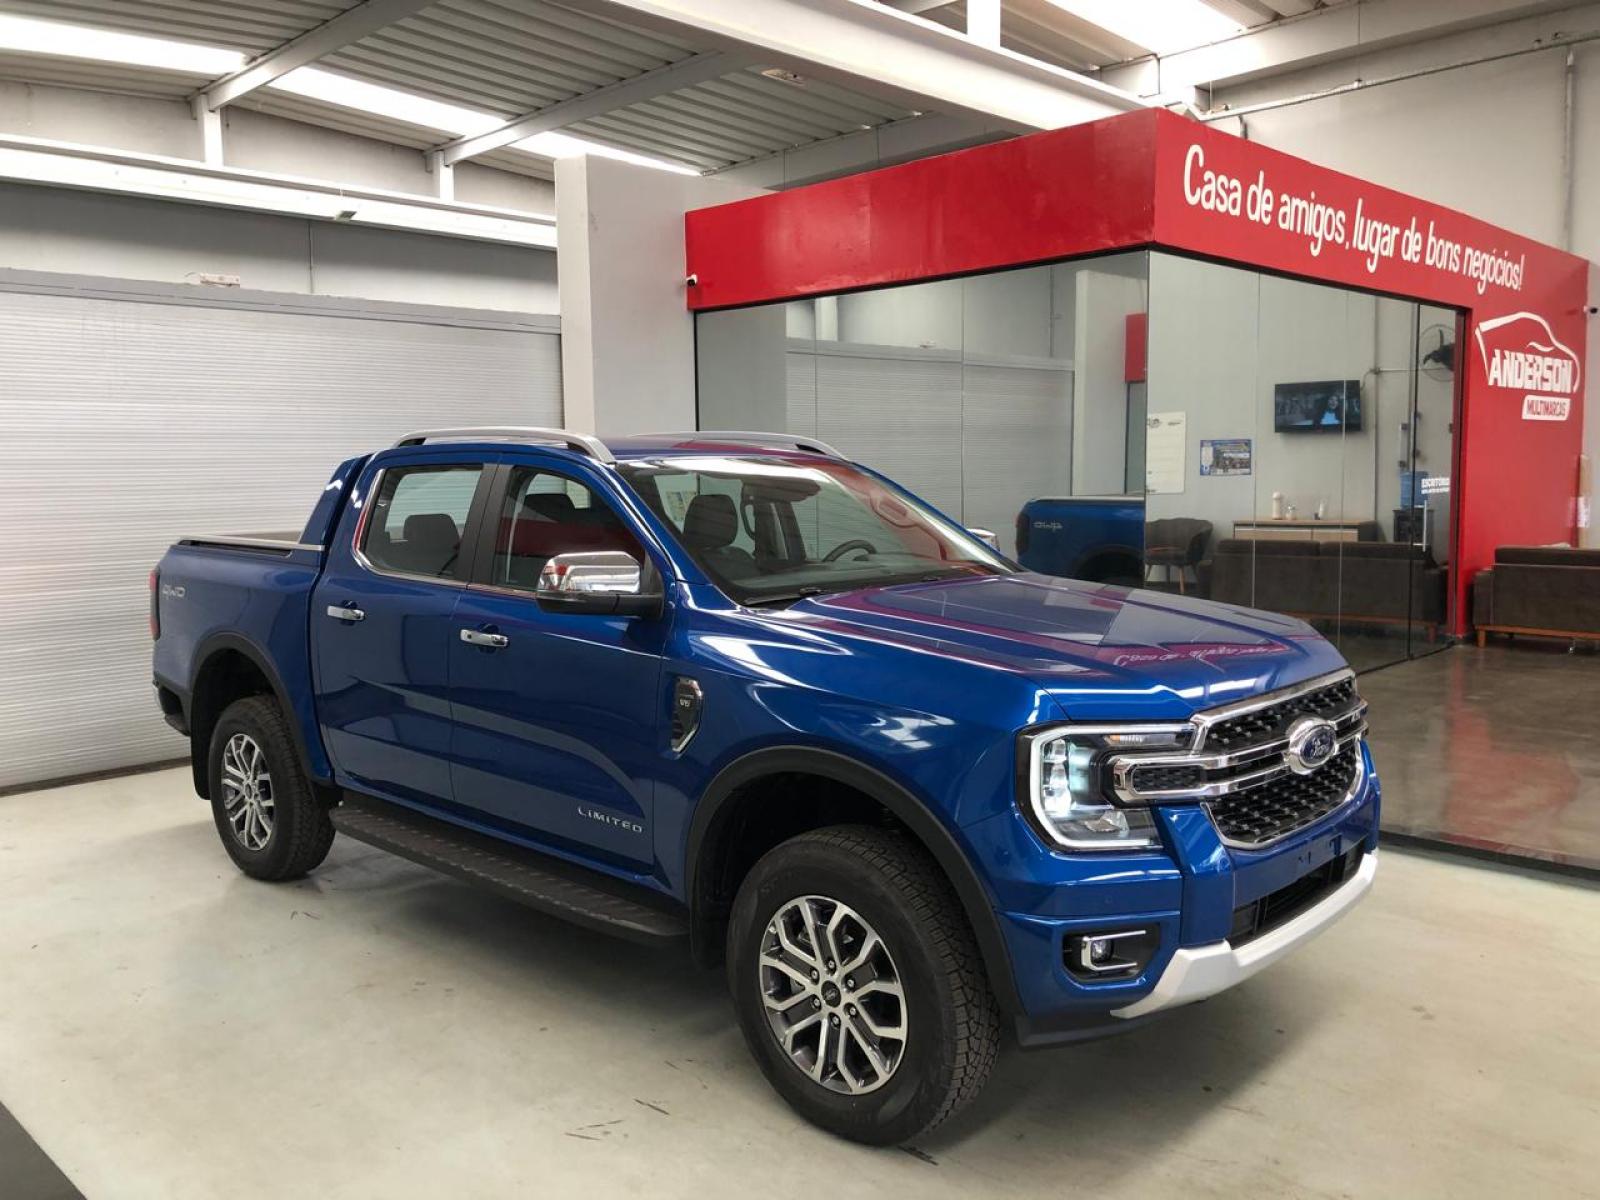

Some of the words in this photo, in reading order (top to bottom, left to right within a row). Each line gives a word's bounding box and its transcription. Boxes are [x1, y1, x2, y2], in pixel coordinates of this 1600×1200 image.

[1183, 144, 1242, 217] Casa
[1246, 170, 1274, 225] de
[1352, 198, 1401, 274] lugar
[1400, 216, 1423, 264] de
[1425, 220, 1461, 273] bons
[1462, 247, 1526, 295] negócios!
[1487, 349, 1572, 393] ANDERSON
[1526, 399, 1567, 416] MULTIMARCAS
[577, 806, 643, 833] LIMITED
